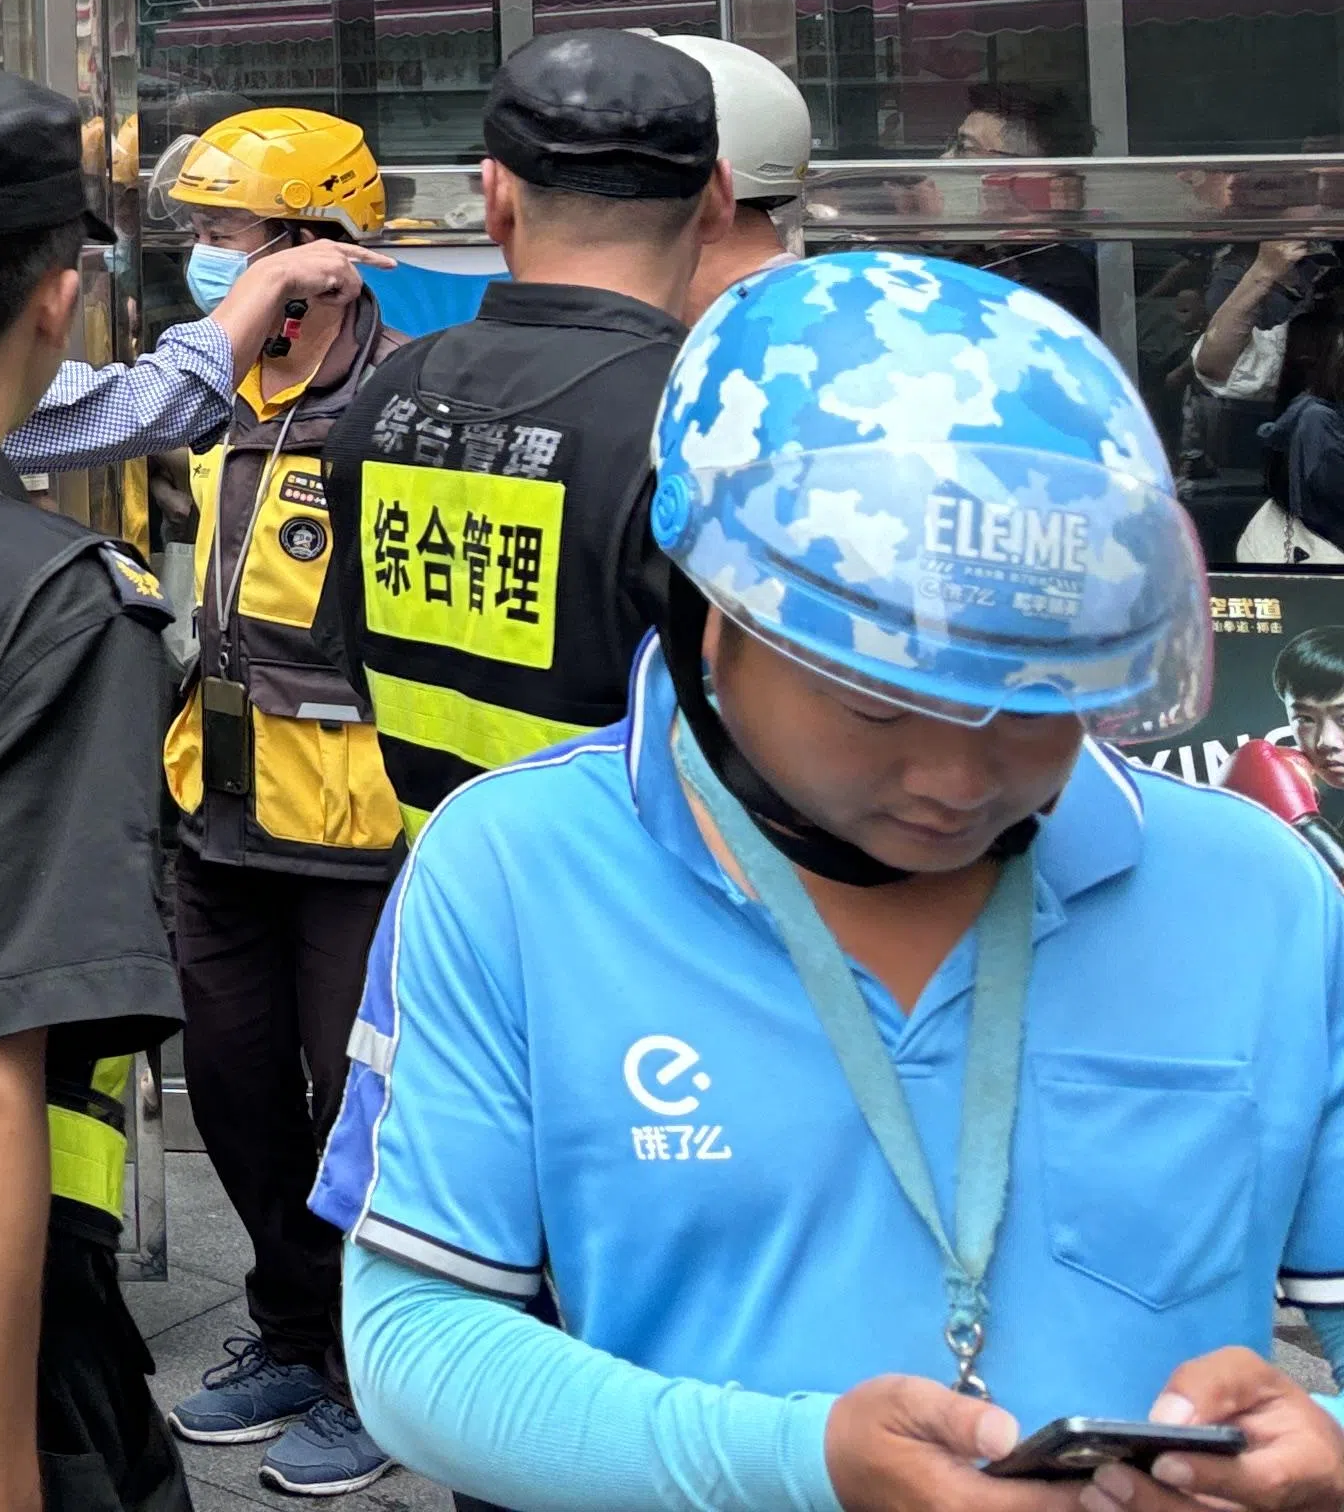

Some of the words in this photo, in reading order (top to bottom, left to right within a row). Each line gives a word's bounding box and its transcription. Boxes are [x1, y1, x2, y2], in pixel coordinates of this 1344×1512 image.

[372, 497, 543, 625] 综合管理
[630, 1124, 732, 1161] 饿了么
